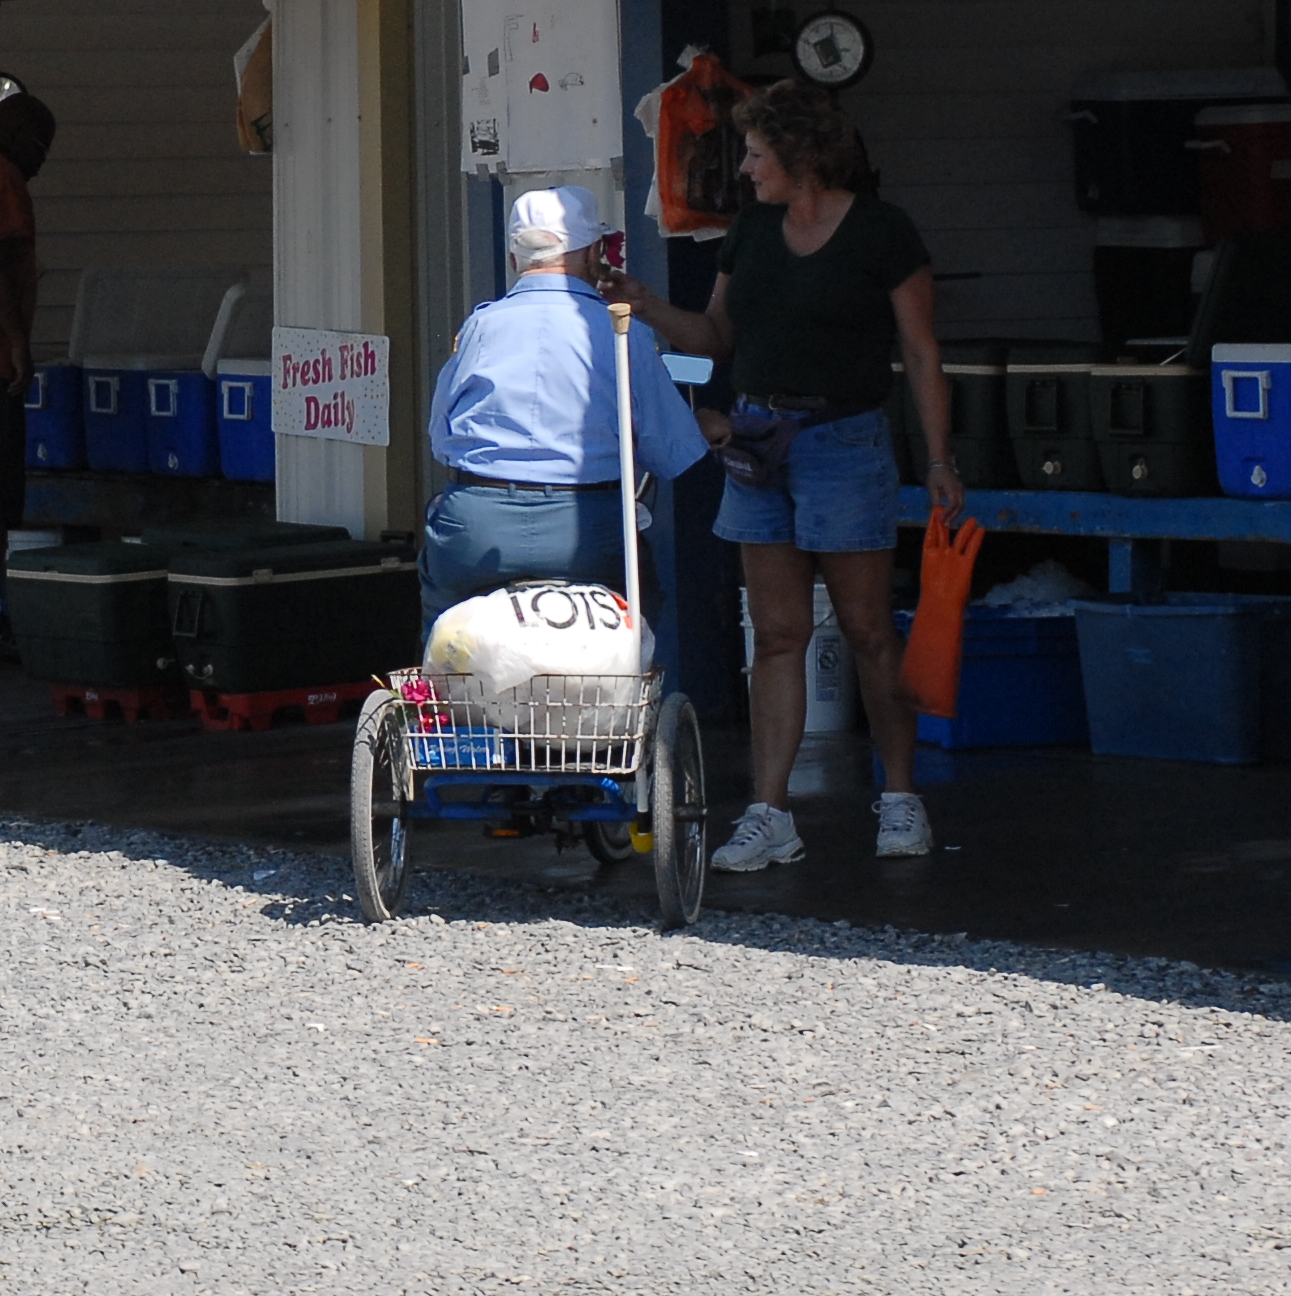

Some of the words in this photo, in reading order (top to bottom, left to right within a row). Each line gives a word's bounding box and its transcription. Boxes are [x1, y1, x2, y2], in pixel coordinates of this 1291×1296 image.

[281, 348, 334, 390] Fresh
[338, 341, 377, 382] Fish
[304, 390, 356, 434] Daily
